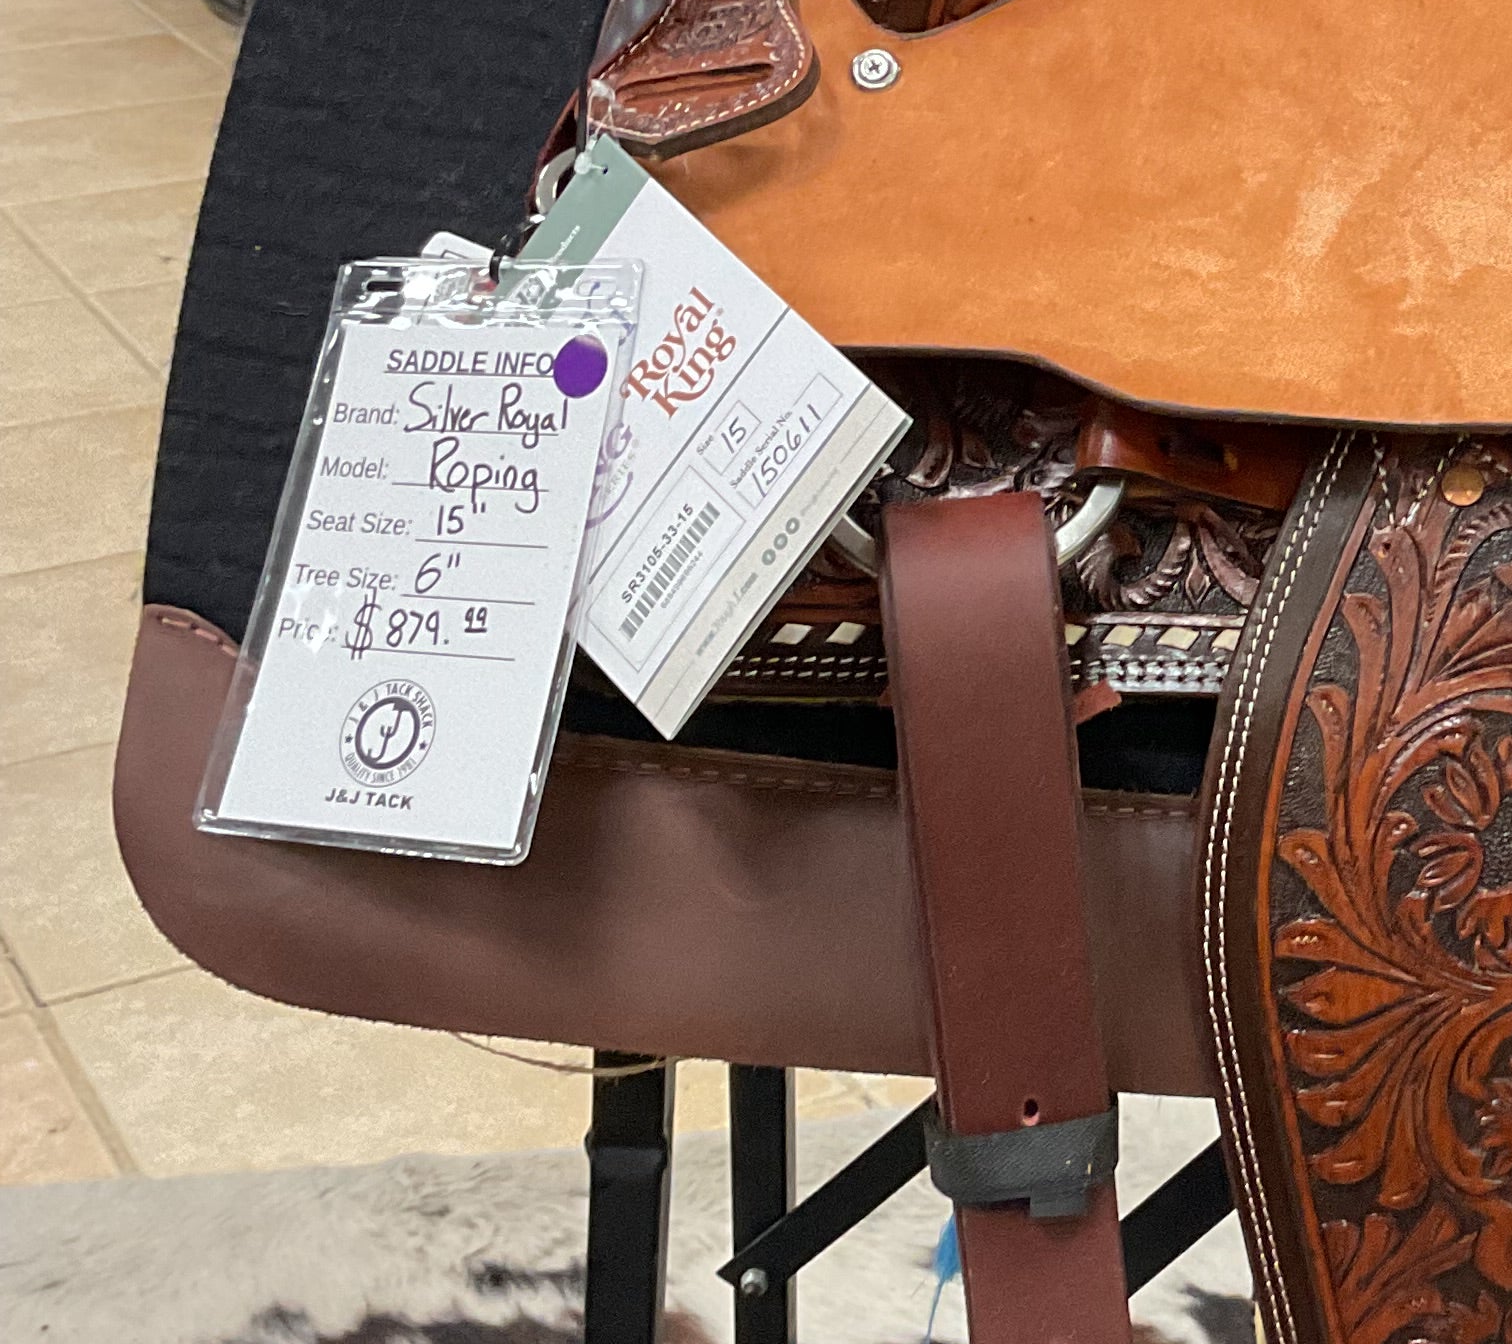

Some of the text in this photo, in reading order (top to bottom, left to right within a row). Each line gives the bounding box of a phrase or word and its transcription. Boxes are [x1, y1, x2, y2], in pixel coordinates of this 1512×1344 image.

[386, 349, 555, 375] SADDLE INFO
[619, 286, 715, 401] Royal
[652, 319, 736, 420] King
[333, 381, 568, 449] Brand: Silver Royal
[721, 416, 747, 453] 15
[696, 434, 715, 455] Size
[730, 457, 757, 489] Saddle
[755, 425, 778, 455] Serial
[752, 404, 822, 498] 150611
[320, 456, 390, 480] Model:
[430, 436, 539, 513] Roping
[306, 509, 355, 532] Seat
[360, 513, 413, 536] Size:
[295, 552, 461, 594] Tree Size: 6"
[621, 503, 694, 604] SR3105-33-15
[386, 683, 414, 697] TACK
[413, 691, 433, 729] SHACK
[344, 752, 371, 782] QUALITY
[372, 771, 395, 783] SINCE
[325, 788, 414, 810] J&J TACK
